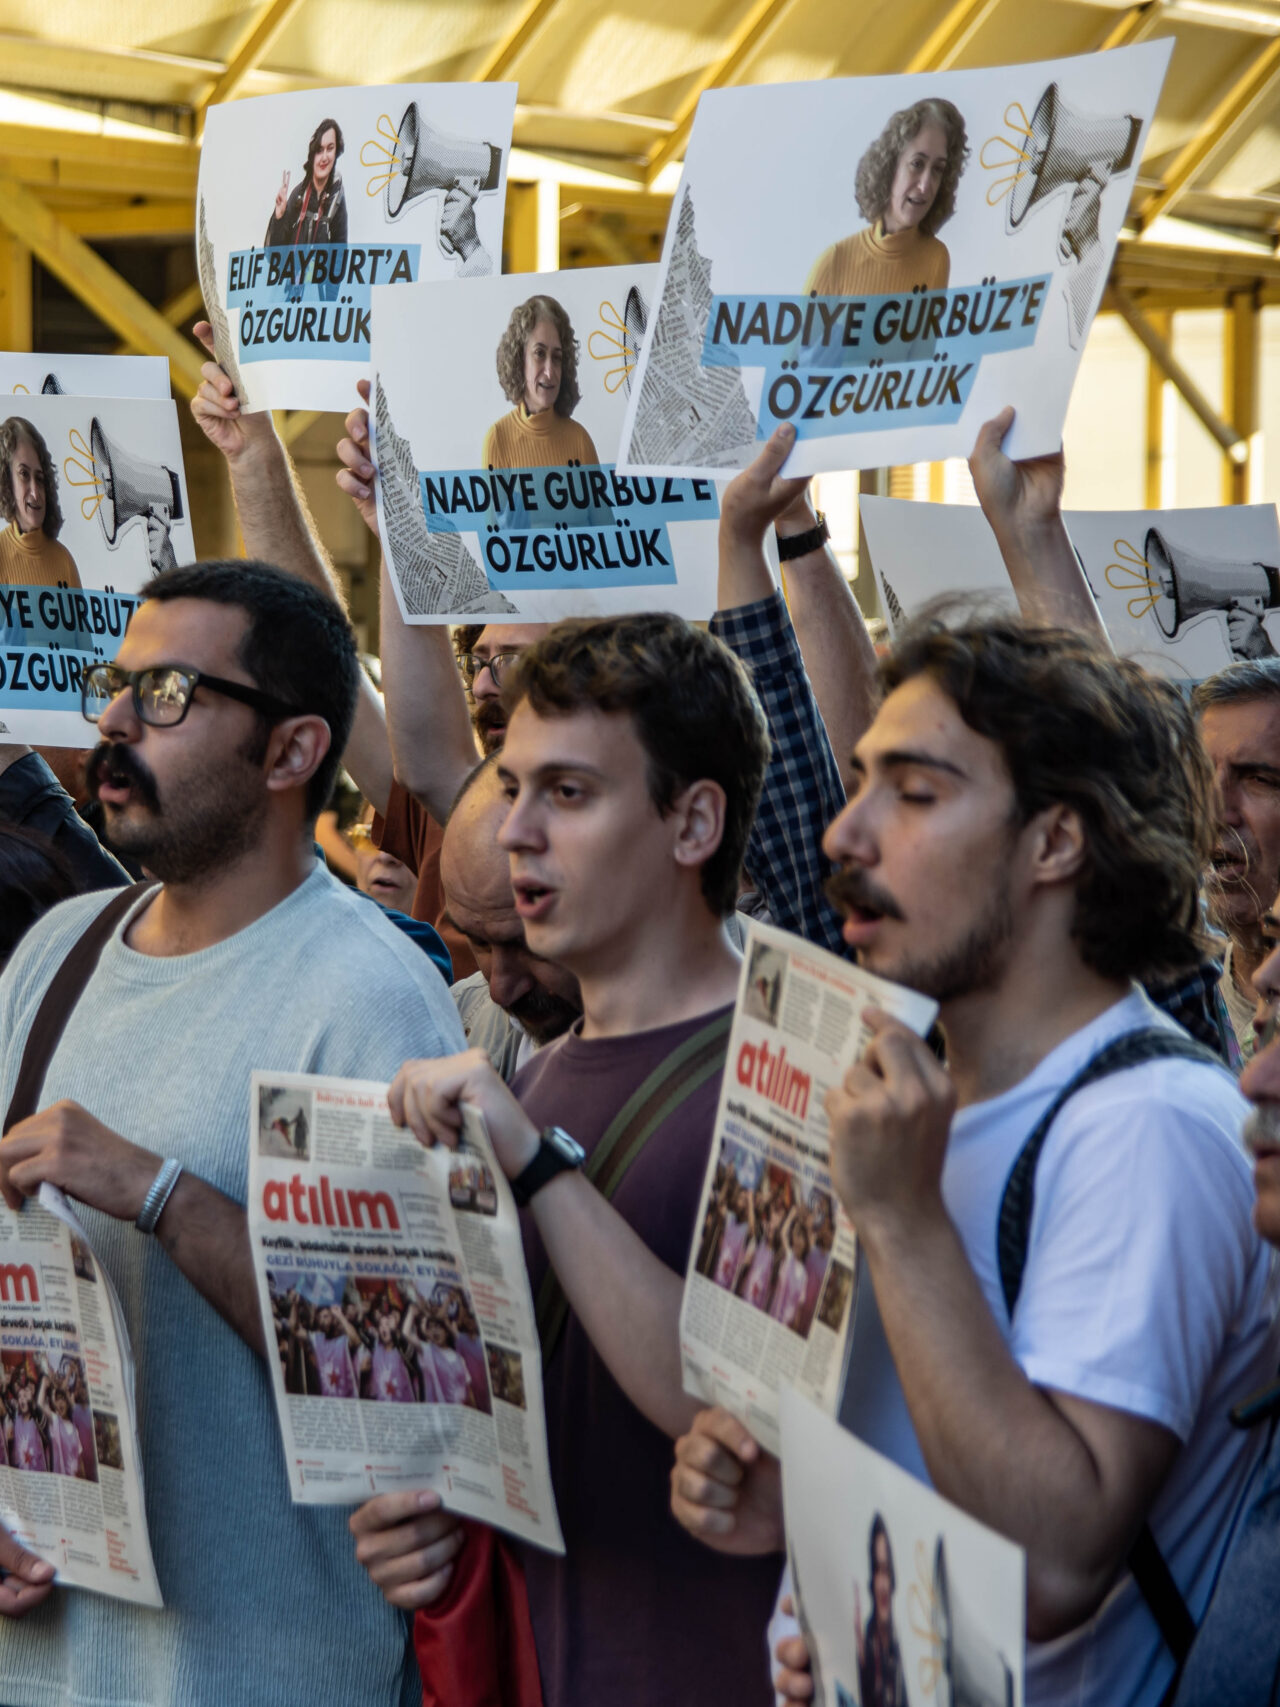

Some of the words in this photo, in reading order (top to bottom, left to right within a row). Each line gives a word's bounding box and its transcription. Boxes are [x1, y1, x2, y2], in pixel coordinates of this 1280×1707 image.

[229, 246, 265, 292] ELİF
[266, 248, 413, 286] BAYBURT'A
[240, 296, 372, 347] ÖZGÜRLÜK
[712, 290, 866, 346] NADİYE
[872, 276, 1046, 345] GÜRBÜZ'E
[767, 353, 975, 420] ÖZGÜRLÜK
[425, 463, 539, 515] NADİYE
[543, 459, 713, 511] GÜRBZE
[486, 519, 670, 574] ÖZGÜRLÜK
[262, 1173, 401, 1231] atılım
